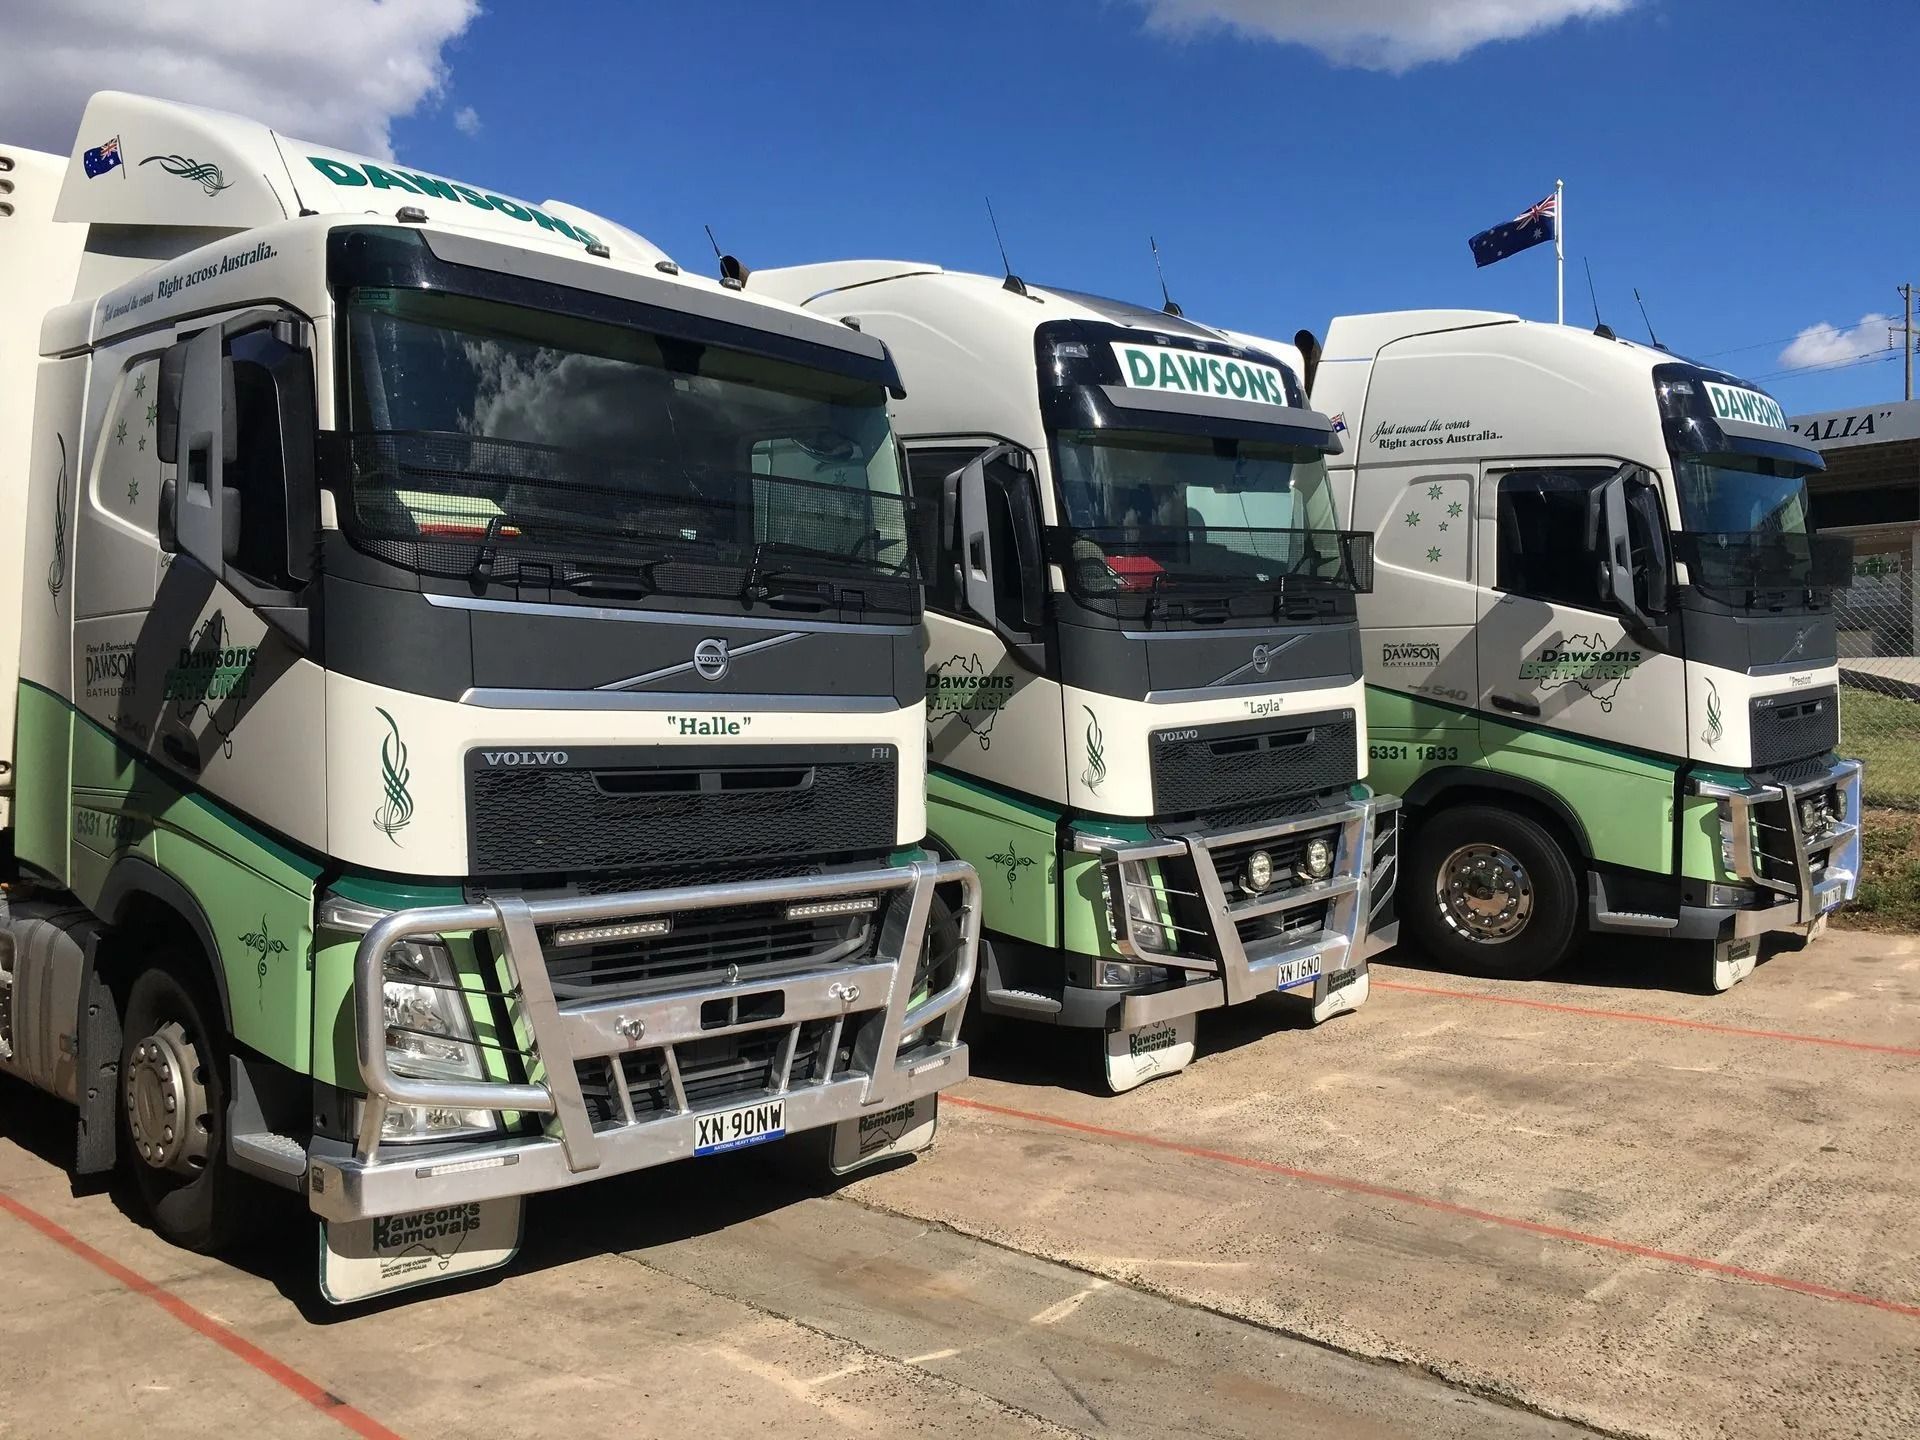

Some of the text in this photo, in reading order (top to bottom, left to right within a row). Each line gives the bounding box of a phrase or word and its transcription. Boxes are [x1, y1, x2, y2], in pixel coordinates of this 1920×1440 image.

[157, 275, 184, 300] Right
[185, 263, 218, 288] across
[1124, 349, 1284, 406] DAWSONS
[1370, 418, 1471, 443] Just around the corner
[1379, 438, 1407, 450] Right
[1409, 437, 1444, 447] across
[179, 647, 258, 669] Dawsons
[696, 655, 727, 663] VOLVO
[1383, 647, 1440, 662] DAWSON
[1541, 649, 1641, 662] Dawsons
[86, 652, 137, 687] DAWSON
[926, 673, 1014, 689] Dawsons
[86, 687, 137, 697] BATHURST
[1432, 685, 1469, 701] 540
[1244, 697, 1284, 717] "Layla"
[667, 715, 752, 737] "Halle"
[1157, 729, 1198, 742] VOLVO
[482, 750, 569, 766] VOLVO
[871, 747, 890, 760] FH
[1369, 745, 1459, 761] 6331 1833
[1129, 1027, 1177, 1046] Dawson's
[1130, 1037, 1176, 1059] Removals
[859, 1108, 915, 1133] Removals
[713, 1134, 767, 1151] NATIONAL HEAVY VEHICLE
[373, 1217, 480, 1251] Removals
